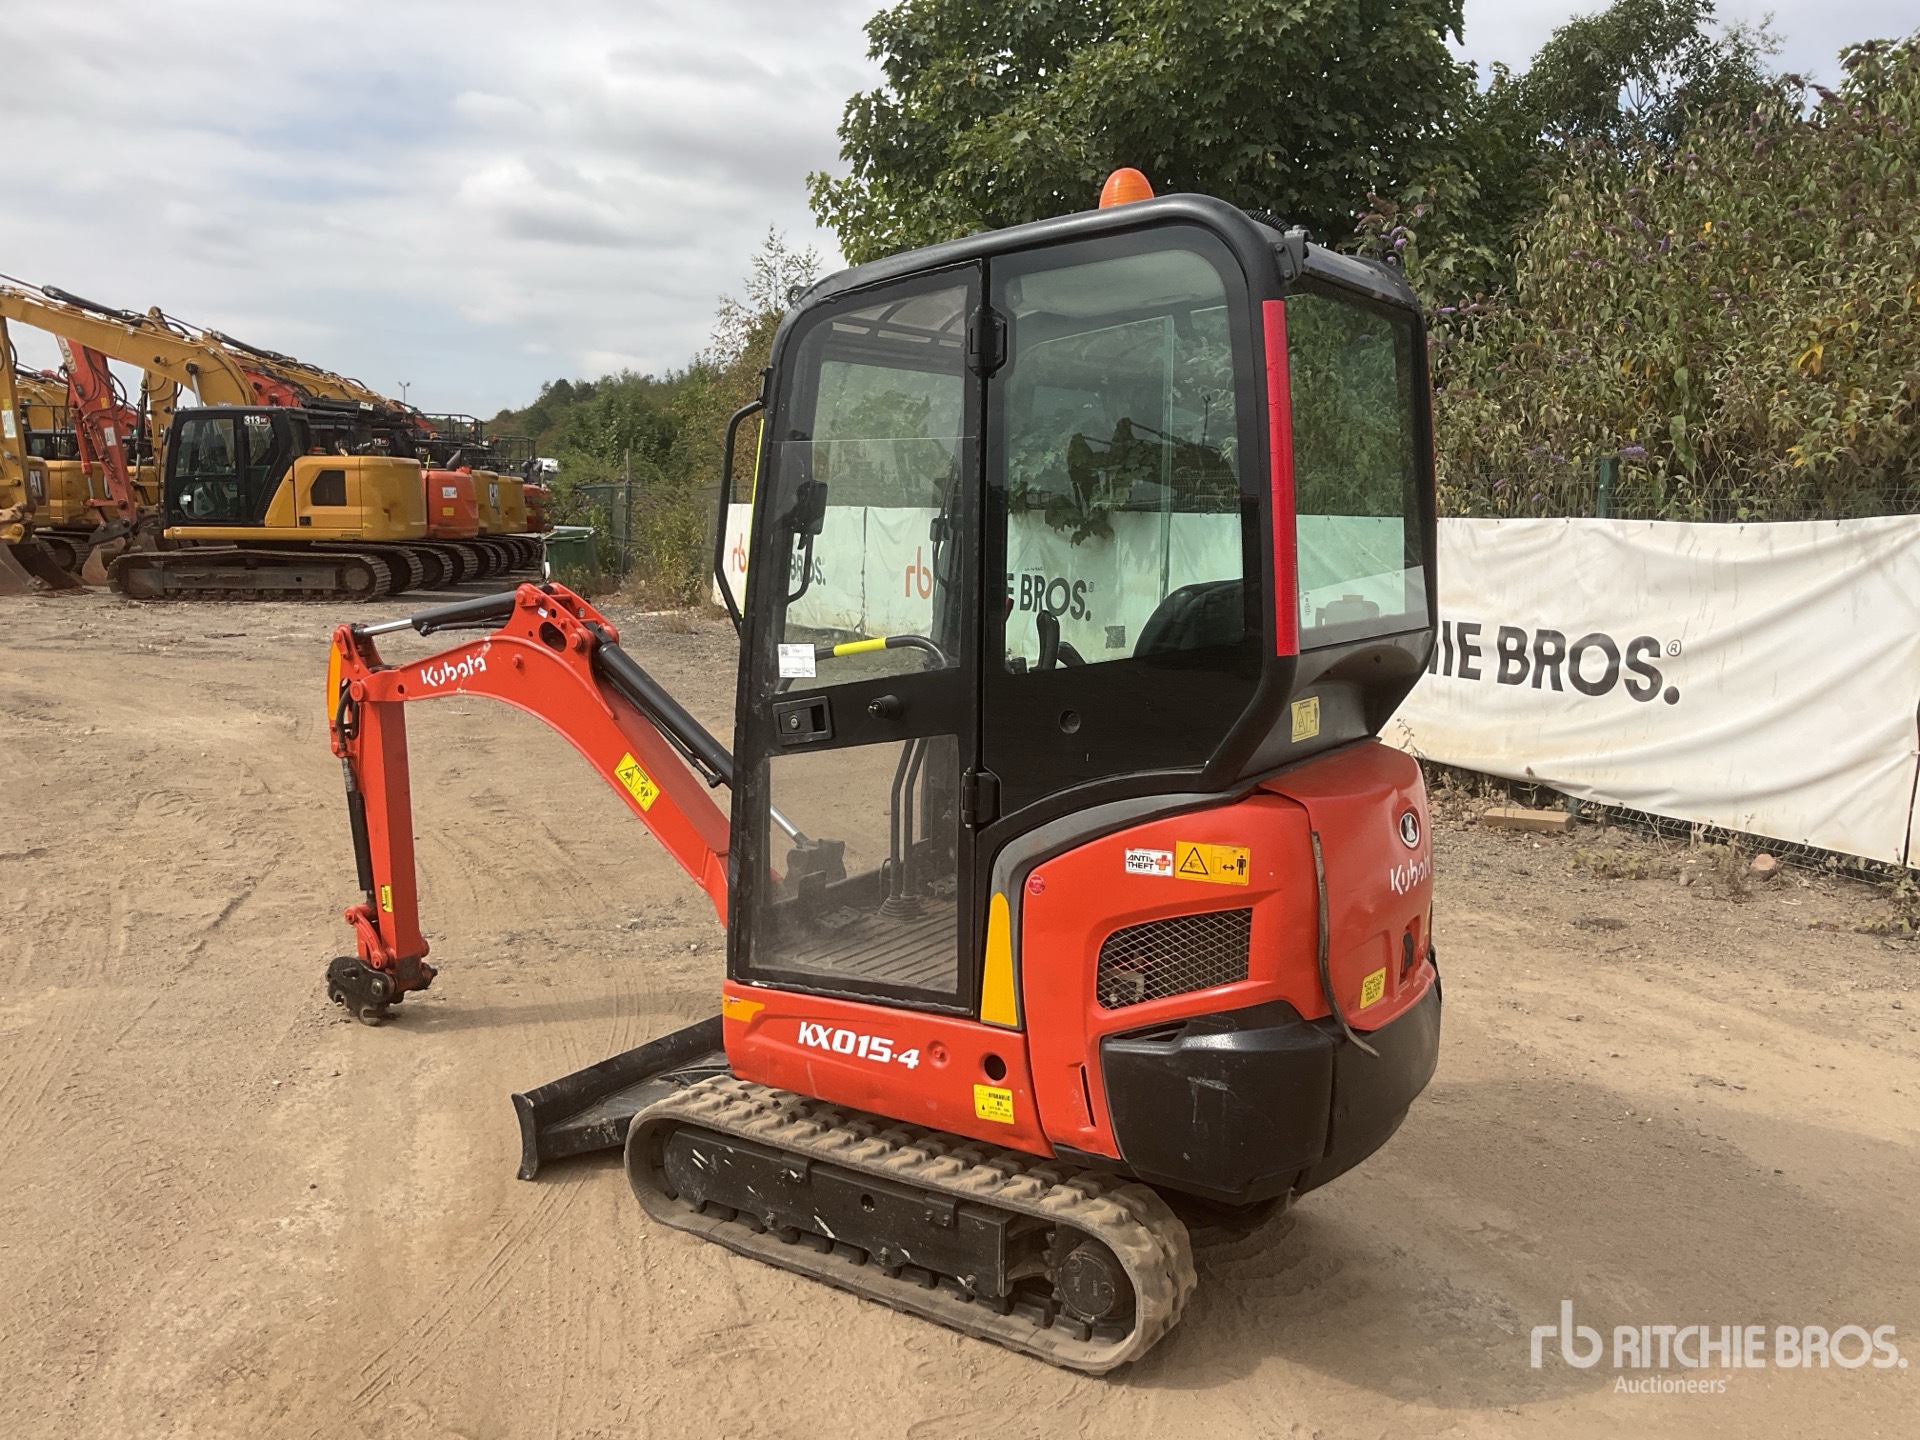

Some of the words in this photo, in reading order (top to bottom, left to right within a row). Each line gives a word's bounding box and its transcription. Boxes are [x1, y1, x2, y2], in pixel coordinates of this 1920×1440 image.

[244, 415, 260, 425] 313
[905, 546, 932, 600] rb
[421, 654, 487, 687] Kubota
[1127, 860, 1154, 870] THEFT
